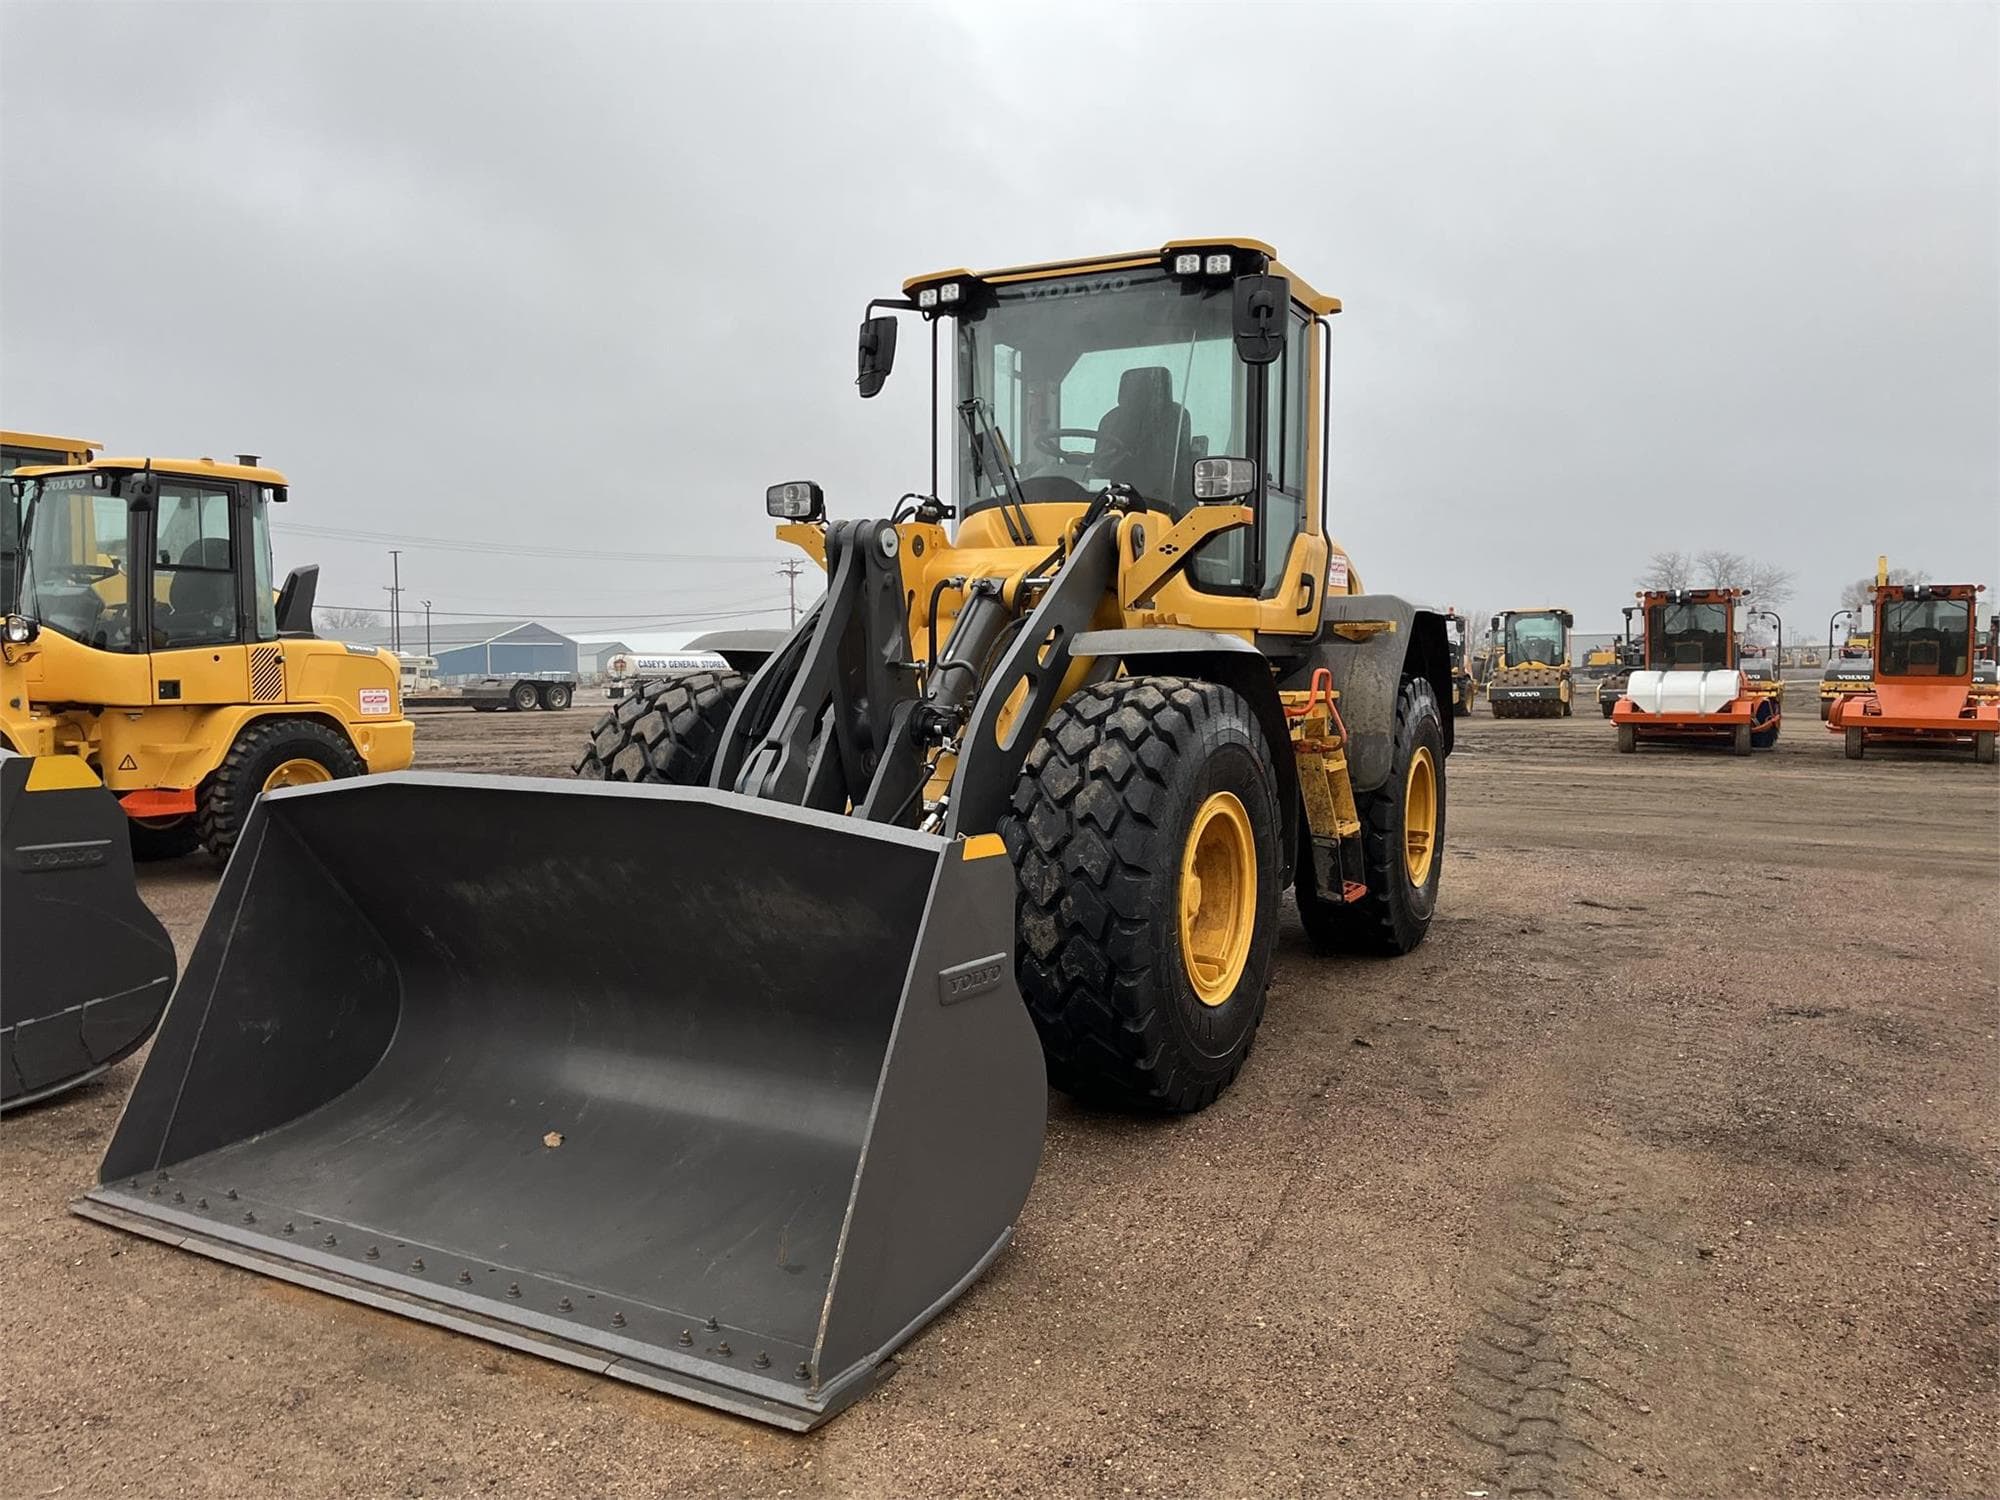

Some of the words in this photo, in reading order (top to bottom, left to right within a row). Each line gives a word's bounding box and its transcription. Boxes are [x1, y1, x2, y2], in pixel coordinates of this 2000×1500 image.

[1021, 276, 1131, 301] VOLVO
[43, 479, 86, 491] VOLVO
[638, 660, 666, 669] CASEY'S
[669, 660, 699, 669] GENERAL
[701, 660, 726, 669] STORES
[947, 964, 1001, 994] VOLVO
